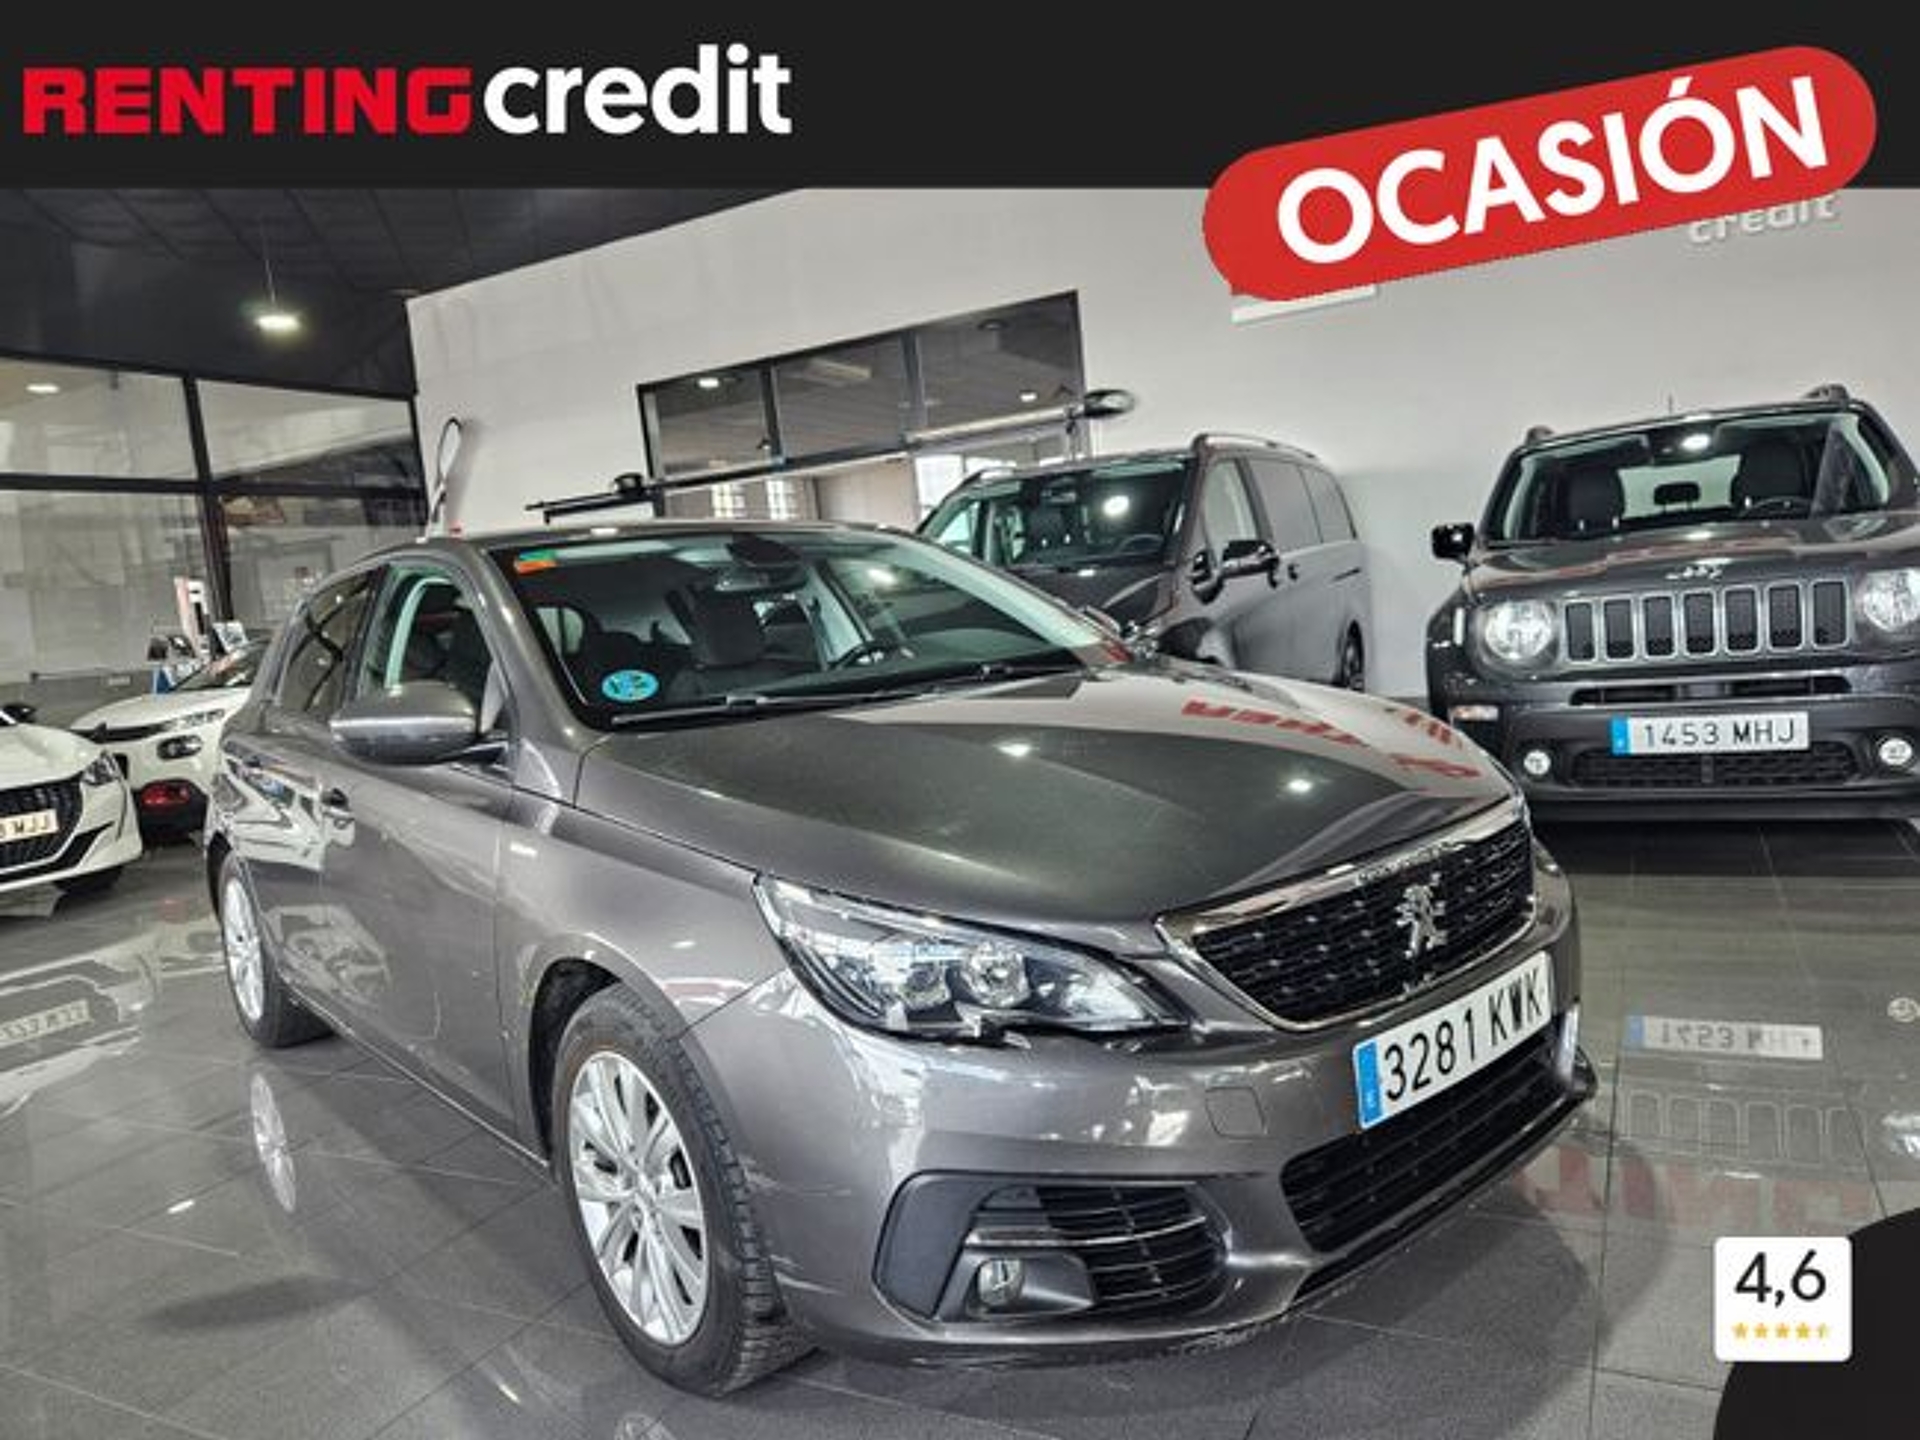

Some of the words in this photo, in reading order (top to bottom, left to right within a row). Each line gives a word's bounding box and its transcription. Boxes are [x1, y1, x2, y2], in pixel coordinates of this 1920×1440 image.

[1645, 720, 1720, 747] 1453
[1733, 718, 1794, 744] MHJ
[1384, 1006, 1476, 1101] 3281
